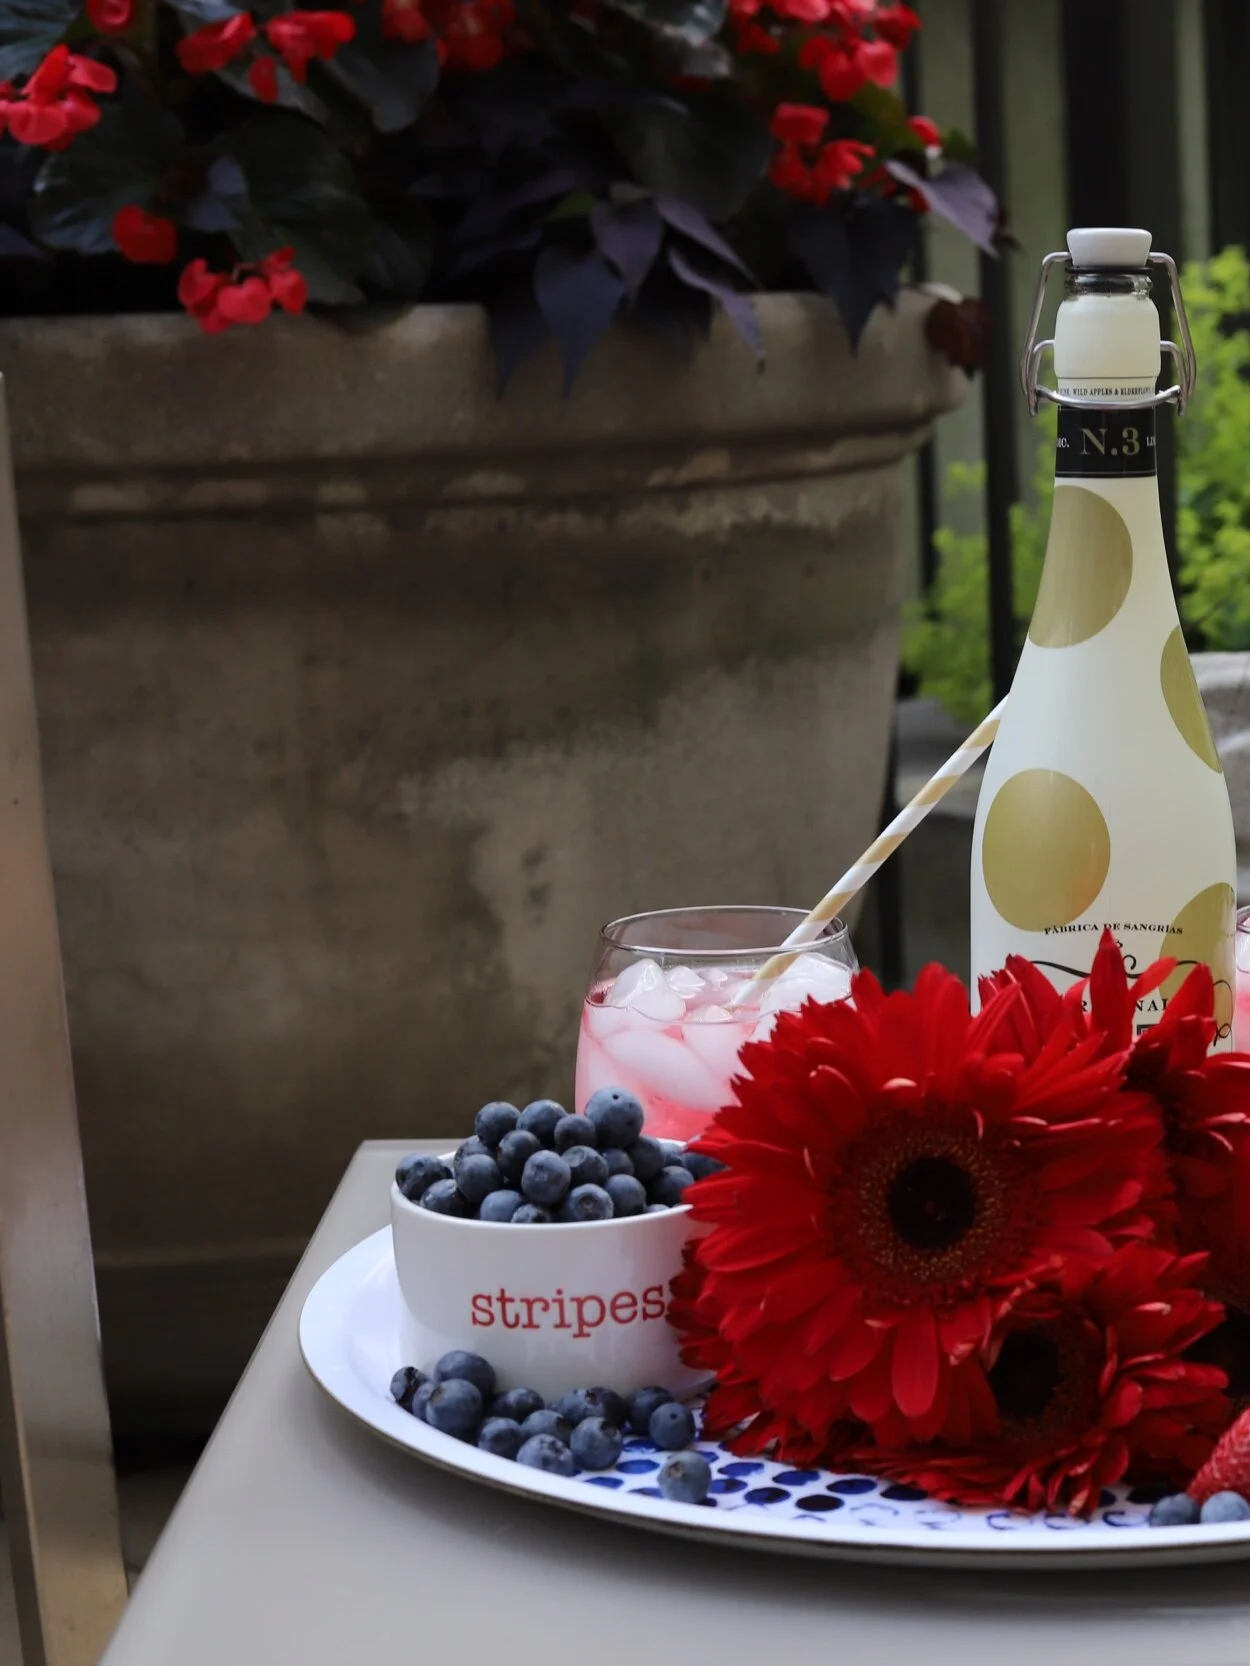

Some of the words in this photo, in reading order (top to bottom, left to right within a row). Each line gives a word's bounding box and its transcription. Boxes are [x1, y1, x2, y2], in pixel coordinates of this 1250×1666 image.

[1073, 387, 1088, 396] WILD
[1089, 387, 1113, 396] APPLES
[1080, 426, 1140, 456] N.3
[471, 1285, 666, 1339] stripes
